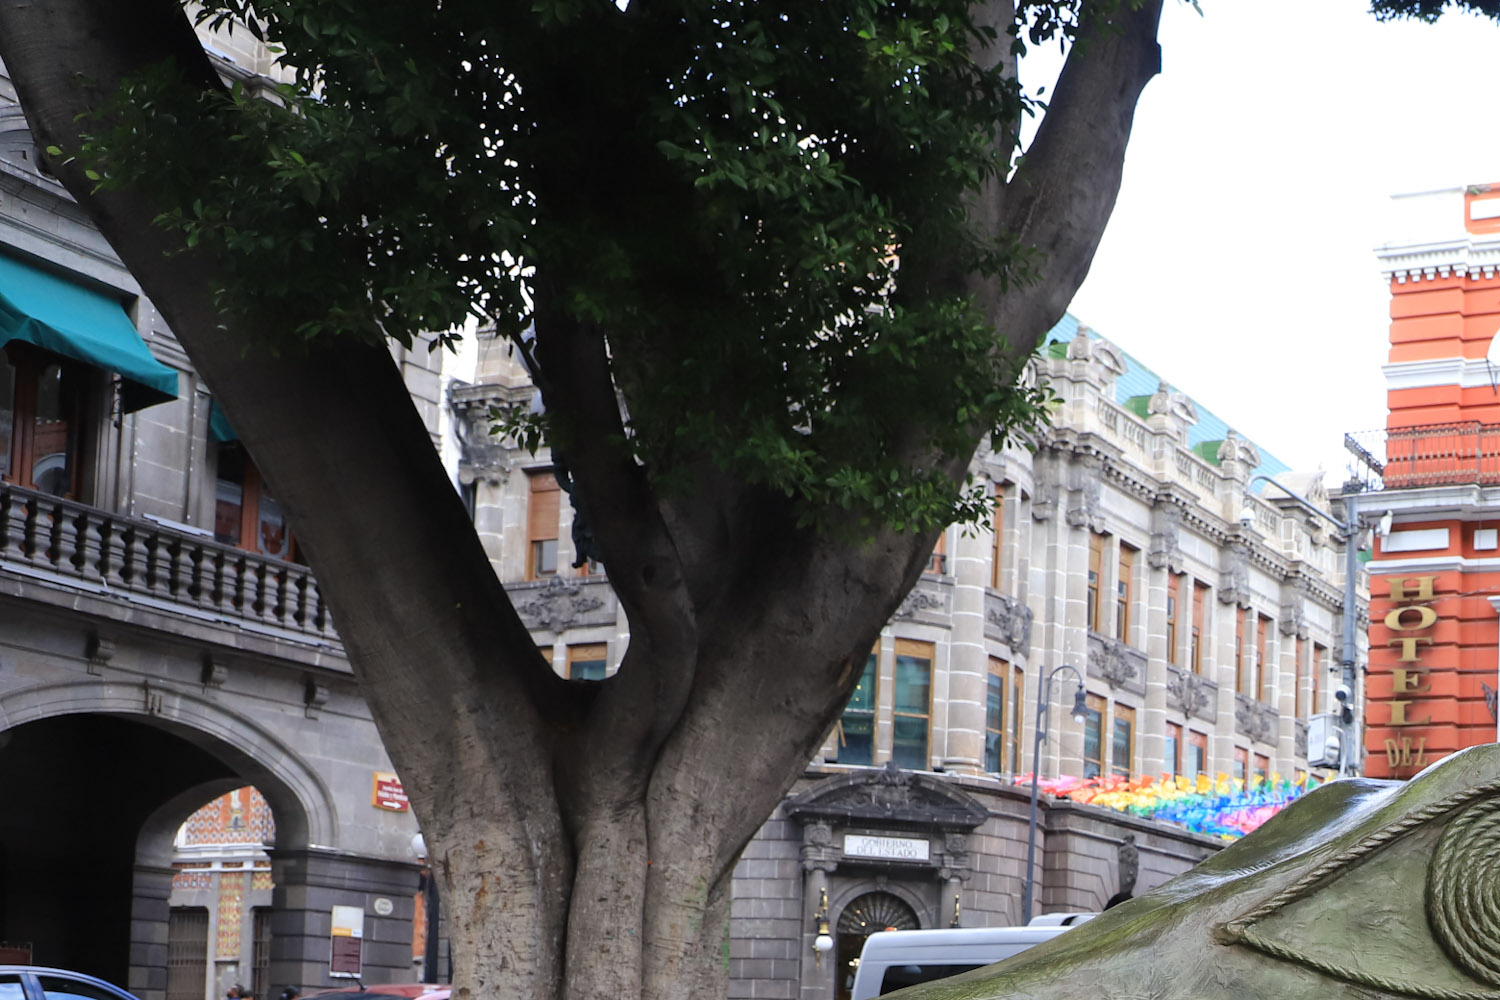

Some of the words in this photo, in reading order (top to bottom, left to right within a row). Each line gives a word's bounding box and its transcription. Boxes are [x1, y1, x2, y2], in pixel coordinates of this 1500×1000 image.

[1384, 576, 1439, 726] HOTEL
[1384, 736, 1429, 768] DEL
[857, 846, 875, 856] DEL
[879, 847, 917, 858] ESTADO
[862, 837, 912, 849] GOBIERNO
